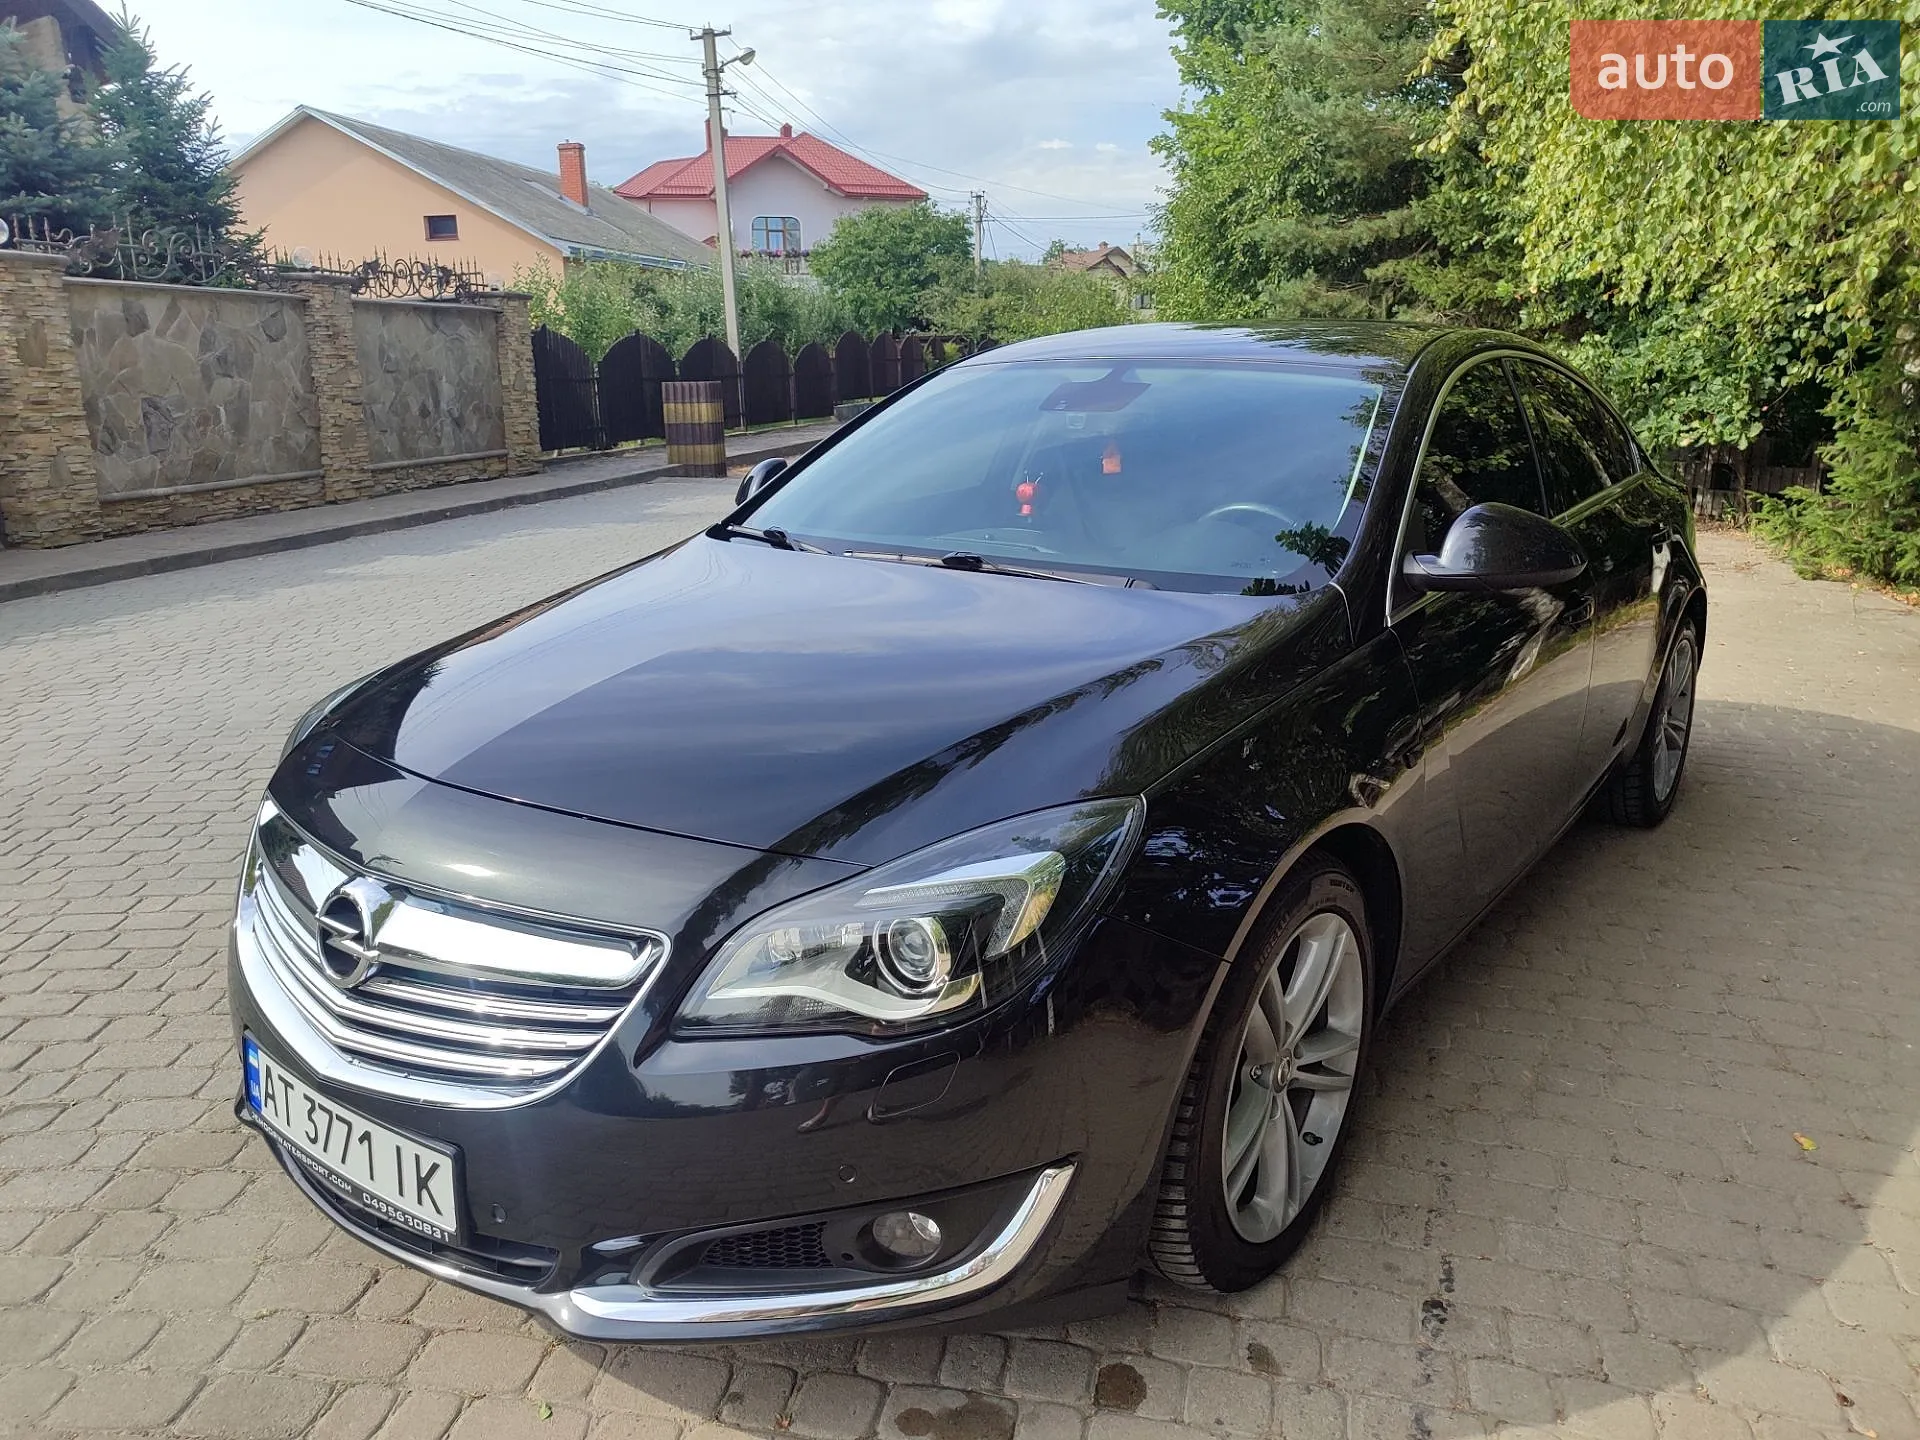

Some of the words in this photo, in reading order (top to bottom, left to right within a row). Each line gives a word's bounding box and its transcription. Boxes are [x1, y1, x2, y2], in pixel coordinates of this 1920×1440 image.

[264, 1064, 294, 1128] AT
[303, 1093, 375, 1181] 3771
[395, 1144, 443, 1216] IK
[362, 1192, 449, 1242] 0495630831
